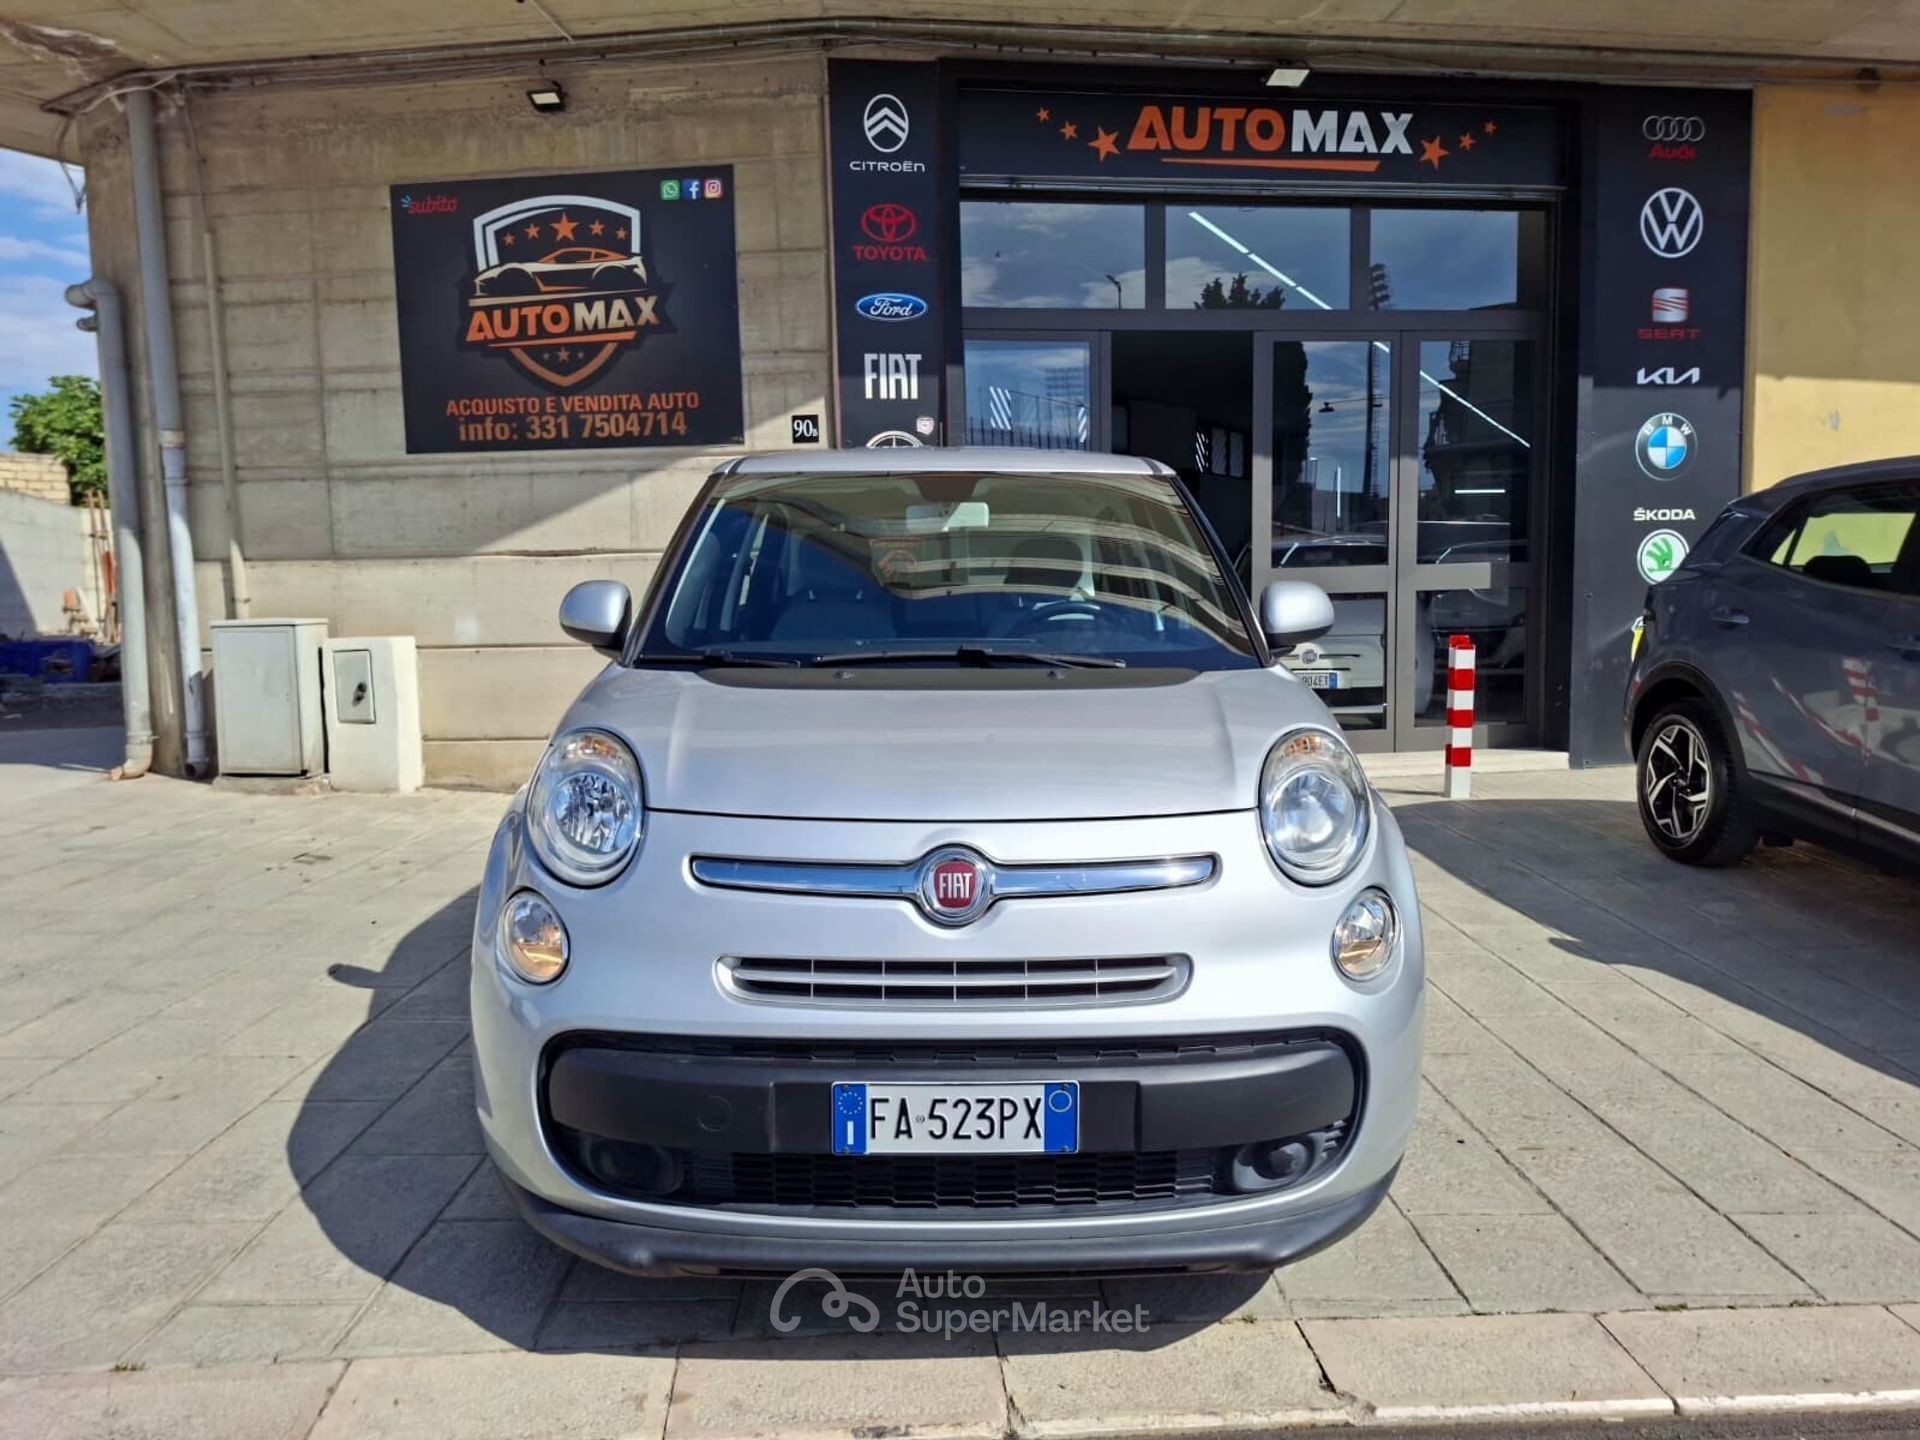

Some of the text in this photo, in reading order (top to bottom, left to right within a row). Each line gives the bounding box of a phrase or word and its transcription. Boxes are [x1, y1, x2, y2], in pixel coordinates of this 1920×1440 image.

[1650, 143, 1697, 160] Audi
[407, 194, 460, 215] subito
[852, 245, 927, 262] TOYOTA
[870, 297, 913, 316] Ford
[1637, 328, 1702, 340] SEAT
[864, 353, 922, 400] FIAT
[1637, 367, 1700, 385] KIA
[446, 392, 699, 416] ACQUISTO E VENDITA AUTO
[459, 411, 687, 441] info: 331 7504714
[1644, 415, 1693, 436] BMW
[1633, 507, 1696, 521] ŠKODA
[939, 872, 973, 899] FIAT
[870, 1097, 913, 1139] FA
[928, 1097, 1042, 1139] 523PX
